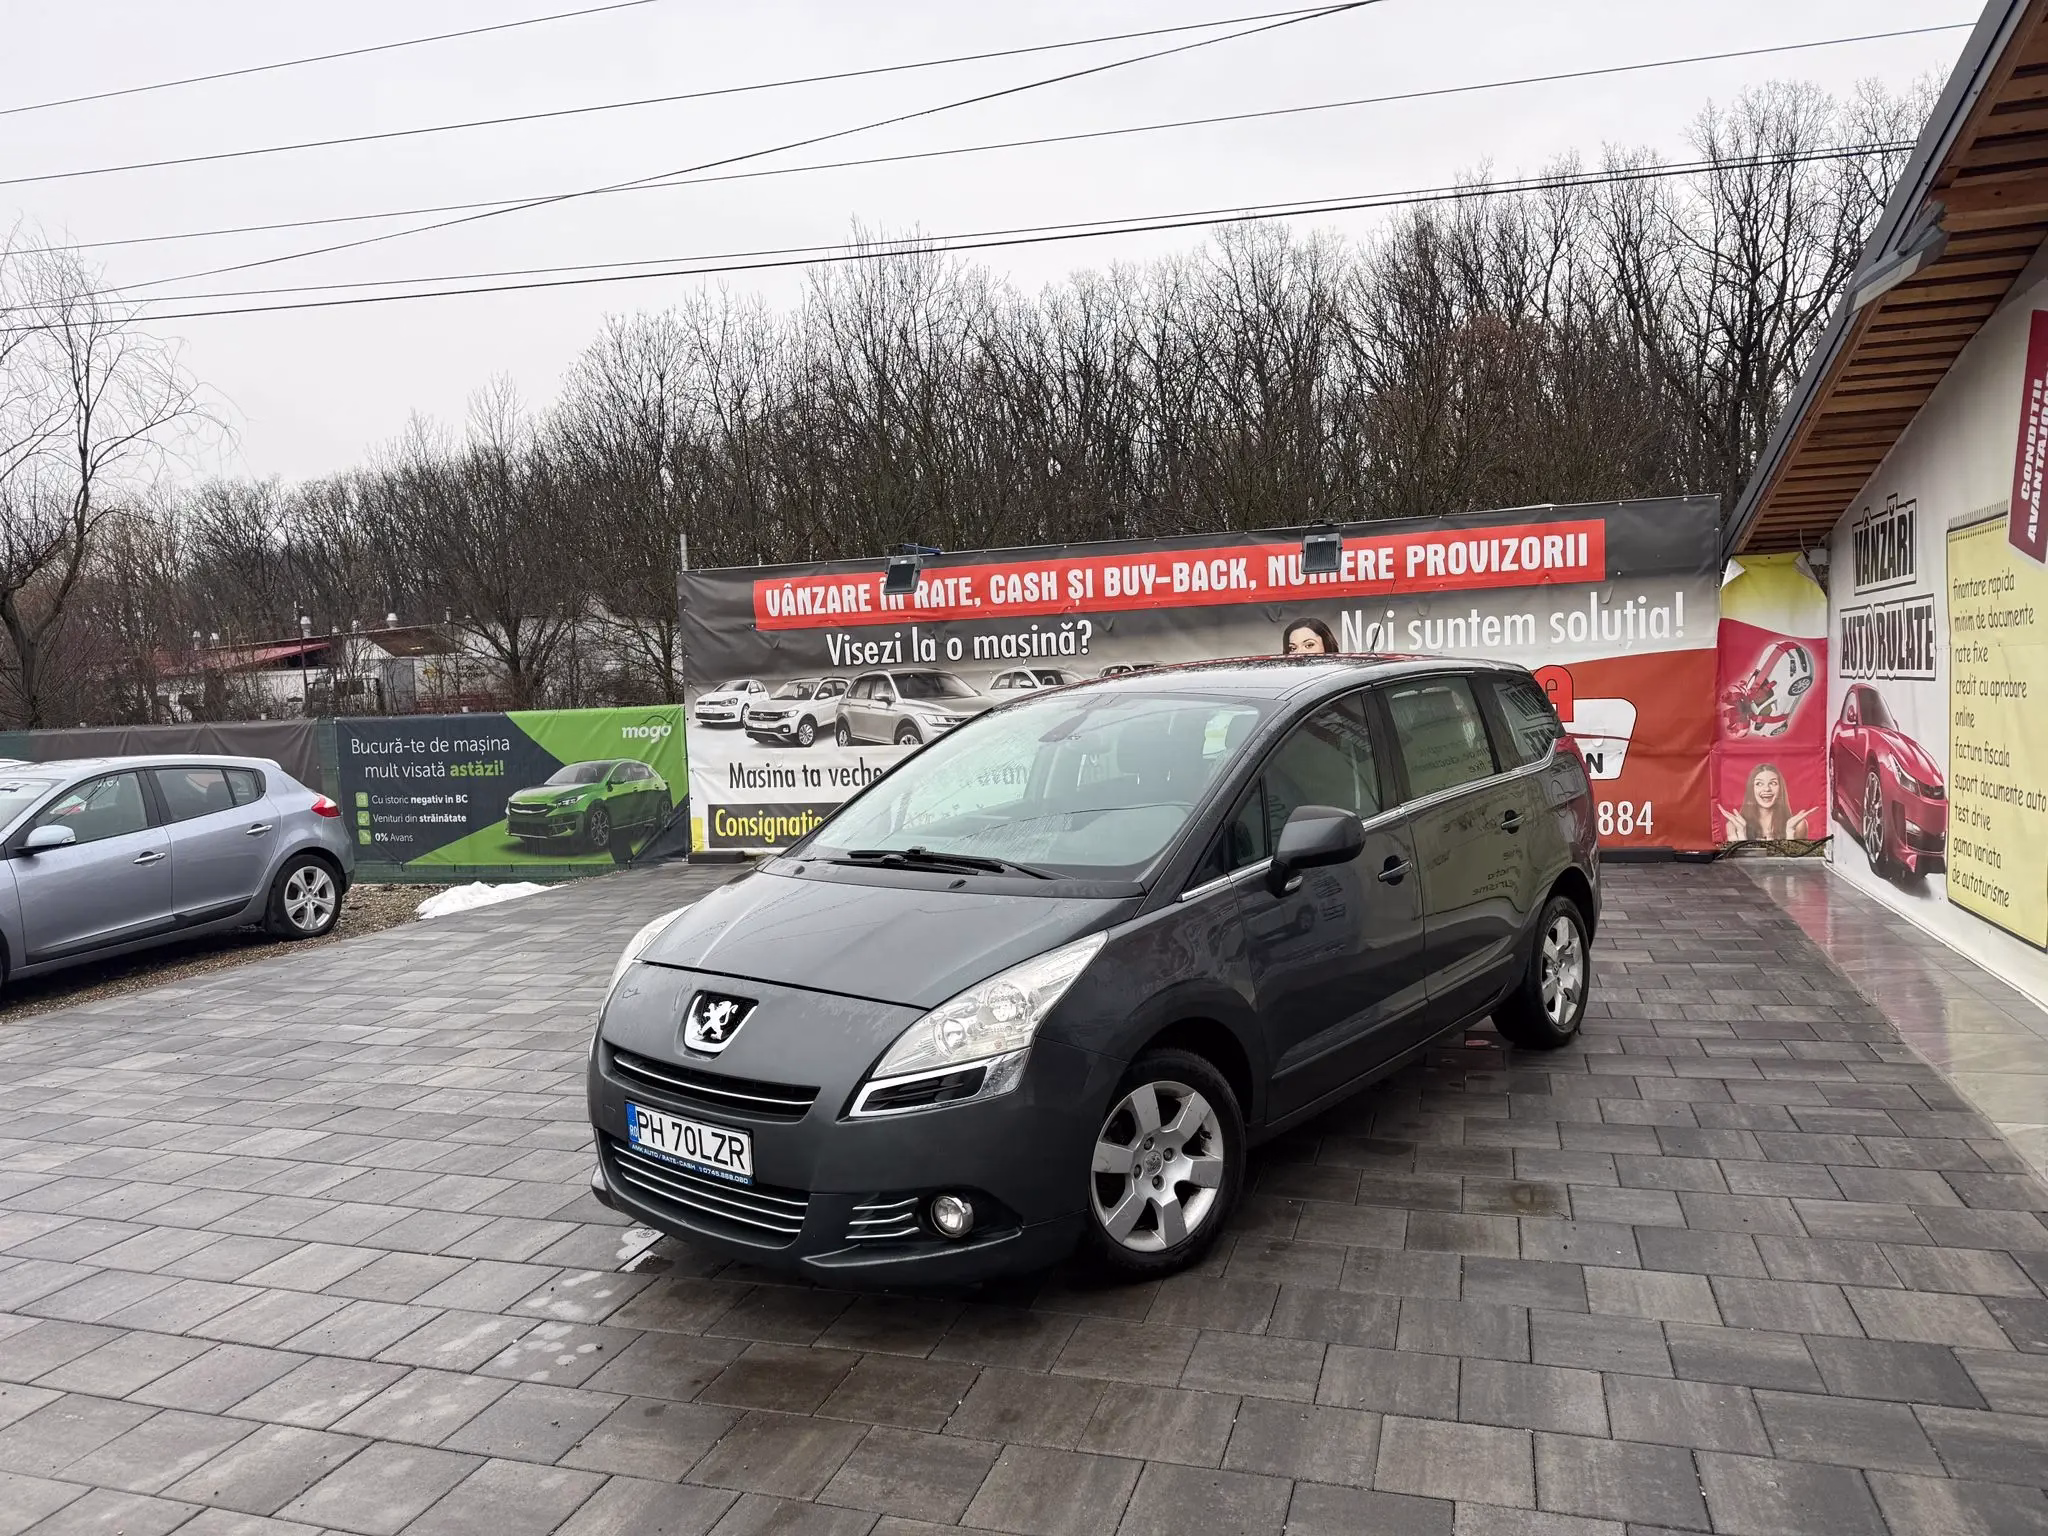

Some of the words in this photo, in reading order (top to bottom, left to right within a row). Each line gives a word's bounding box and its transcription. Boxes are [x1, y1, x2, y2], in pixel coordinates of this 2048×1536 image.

[1855, 504, 1914, 587] VÂNZĂRI
[765, 582, 873, 617] VÂNZARE
[913, 576, 981, 610] RATE,
[989, 570, 1058, 605] CASH
[1067, 568, 1093, 607] ȘI
[1103, 557, 1257, 598] BUY-BACK,
[1267, 547, 1395, 588] NUERE
[1406, 532, 1588, 578] PROVIZORII
[1988, 566, 2015, 600] rapida
[1341, 609, 1394, 653] Noi
[1407, 608, 1536, 651] suntem
[1550, 591, 1684, 650] soluția!
[1954, 609, 1975, 632] minim
[1976, 606, 1986, 629] de
[1988, 602, 2035, 628] documente
[826, 631, 902, 667] Visezi
[911, 626, 936, 663] la
[946, 636, 963, 661] o
[1842, 611, 1875, 671] AUTO
[1876, 605, 1934, 671] RULATE
[1955, 644, 1971, 663] rate
[1972, 640, 1989, 664] fixe
[1955, 673, 1977, 696] credit
[1979, 680, 1989, 696] cu
[1990, 674, 2028, 704] aprobare
[1955, 705, 1975, 728] online
[351, 738, 425, 754] Bucură-te
[429, 736, 449, 753] de
[454, 735, 510, 755] mașina
[621, 725, 673, 744] mogo
[1955, 736, 1982, 762] factura
[1984, 740, 2010, 767] fiscala
[365, 762, 399, 778] mult
[402, 761, 446, 778] visată
[450, 759, 505, 777] astăzi!
[802, 764, 822, 787] ta
[371, 794, 383, 804] Cu
[384, 794, 409, 804] istoric
[410, 794, 443, 806] negativ
[455, 794, 468, 803] BC
[1954, 773, 1978, 796] suport
[1980, 773, 2024, 806] documente
[2026, 788, 2047, 812] auto
[373, 813, 403, 823] Venituri
[404, 813, 418, 823] din
[419, 813, 467, 823] străinătate
[1954, 801, 1969, 823] test
[1971, 804, 1991, 831] drive
[374, 832, 389, 842] 0%
[389, 833, 414, 842] Avans
[1953, 837, 1971, 858] gama
[1974, 843, 2001, 869] variata
[1952, 862, 1961, 884] de
[1961, 871, 2010, 907] autoturisme
[636, 1110, 665, 1147] PH
